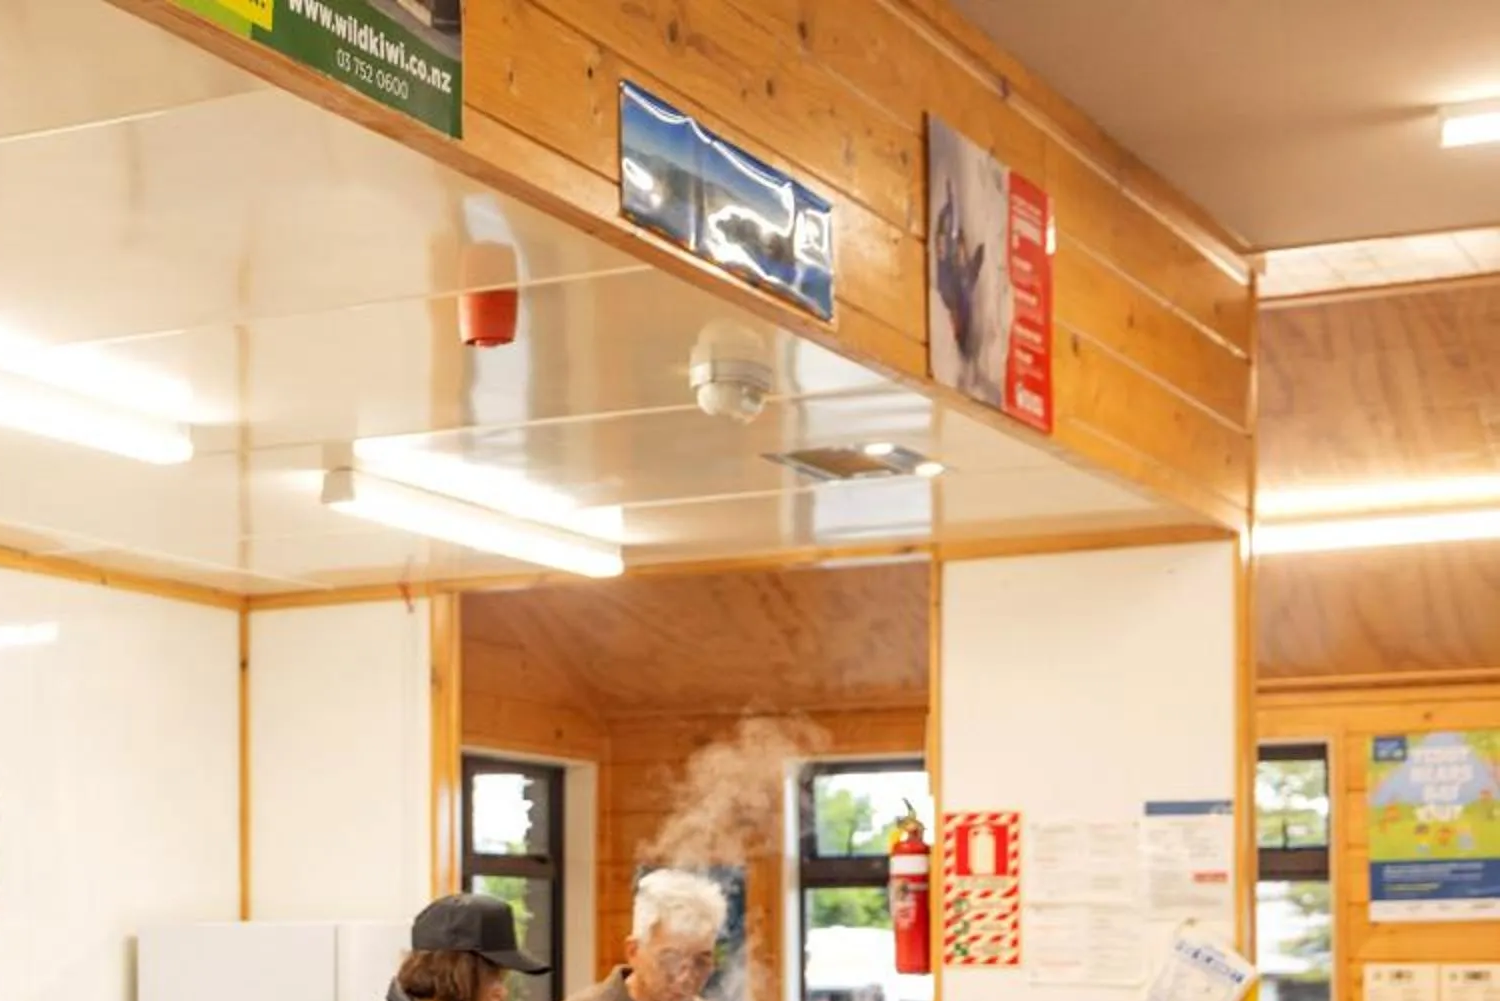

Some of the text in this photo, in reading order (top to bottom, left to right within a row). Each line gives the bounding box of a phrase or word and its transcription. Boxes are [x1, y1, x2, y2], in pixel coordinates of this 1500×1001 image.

[289, 0, 452, 94] www.wildkiwi.co.nz
[336, 48, 410, 100] 03 752 0600
